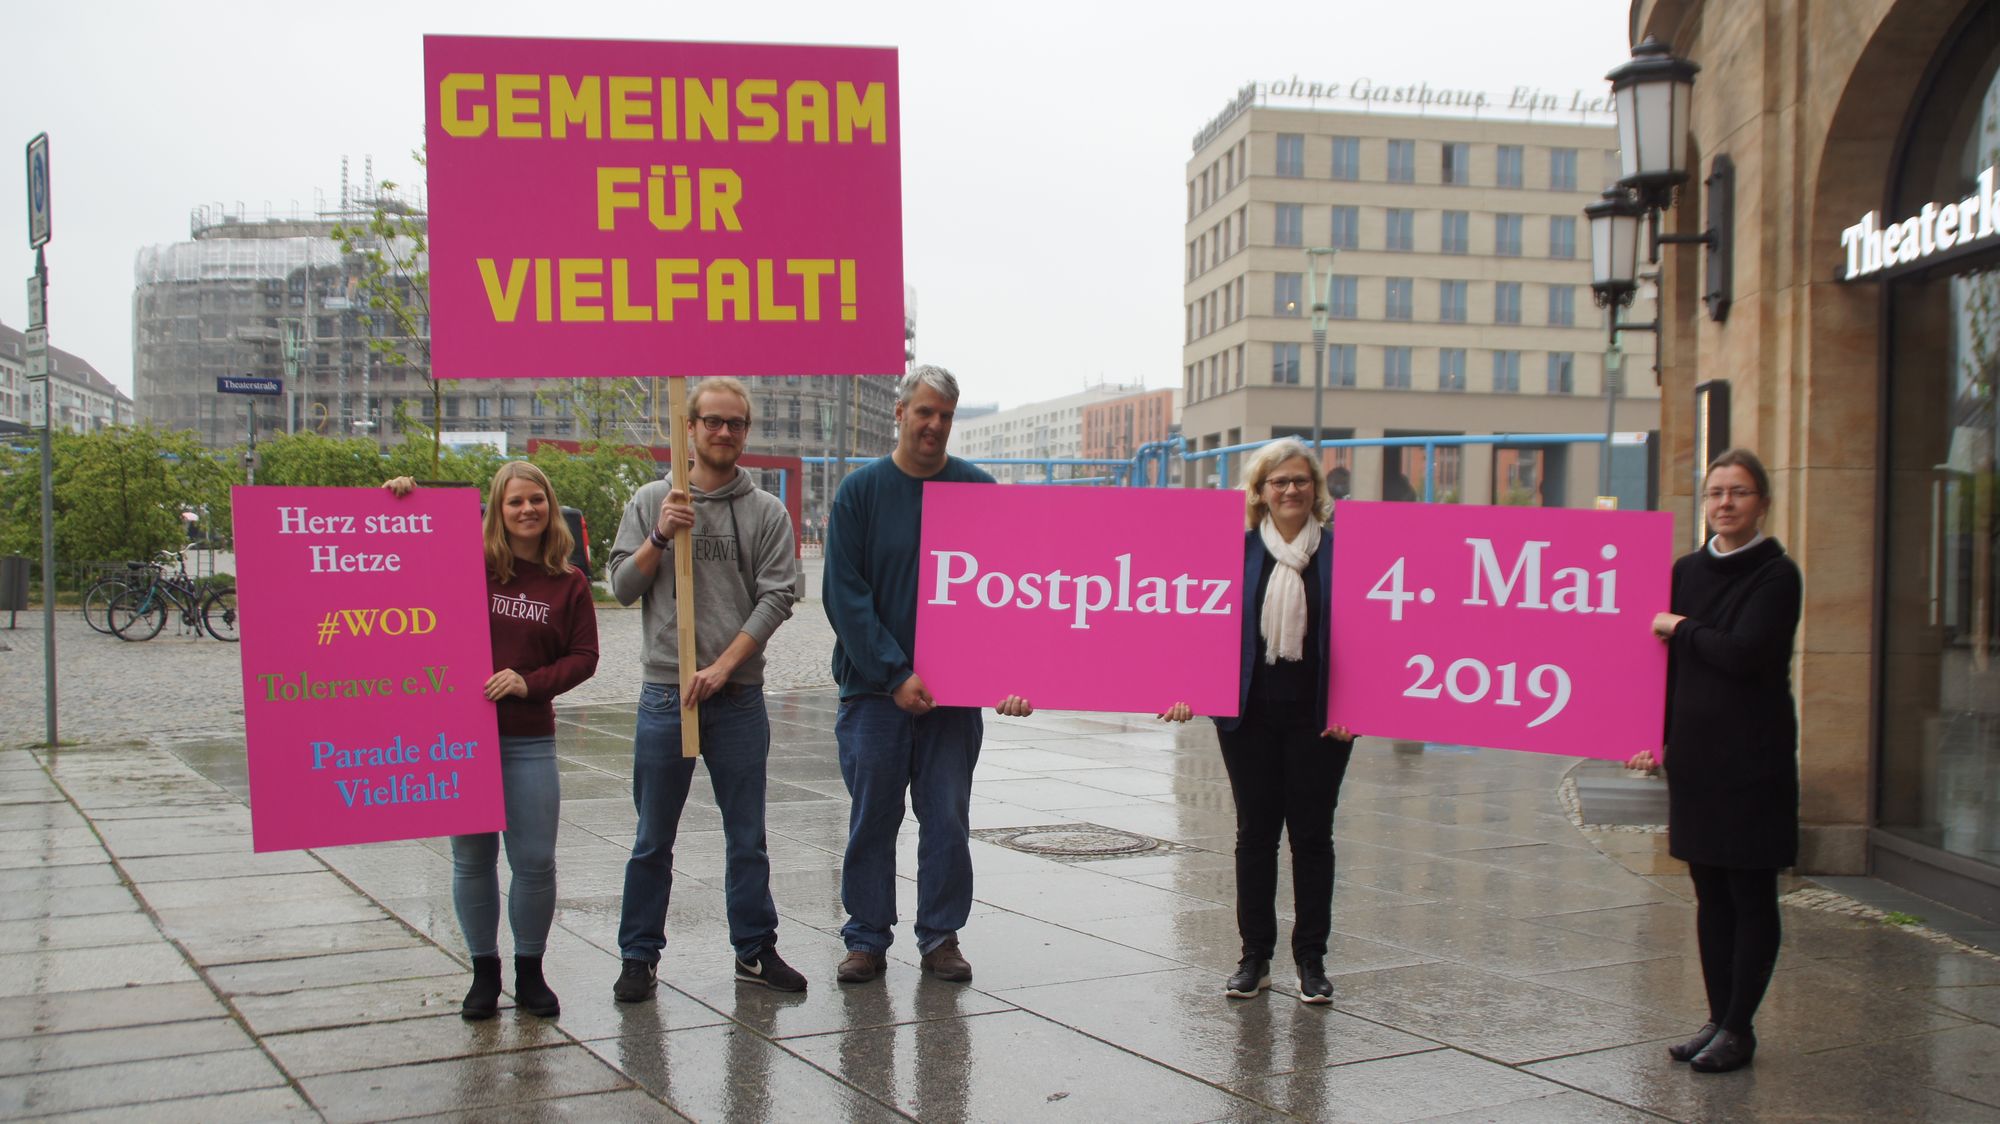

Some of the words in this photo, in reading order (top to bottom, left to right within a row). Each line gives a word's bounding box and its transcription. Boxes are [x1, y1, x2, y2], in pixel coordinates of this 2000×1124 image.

[440, 72, 887, 145] GEMEINSAM
[1271, 73, 1340, 99] ohne
[1508, 85, 1557, 111] Ein
[596, 164, 743, 232] FÜR
[476, 257, 857, 323] VIELFALT!
[223, 379, 278, 391] Theaterstraße
[276, 506, 356, 535] Herz
[365, 512, 434, 535] statt
[308, 545, 401, 573] Hetze
[927, 549, 1232, 630] Postplatz
[1365, 556, 1436, 622] 4.
[1461, 537, 1621, 615] Mai
[317, 607, 437, 646] #WOD
[491, 596, 551, 625] TOLERAVE
[257, 671, 393, 703] Tolerave
[402, 666, 455, 695] e.V.
[1402, 653, 1572, 729] 2019
[310, 735, 420, 770] Parade
[428, 732, 479, 763] der
[334, 771, 461, 808] Vielfalt!
